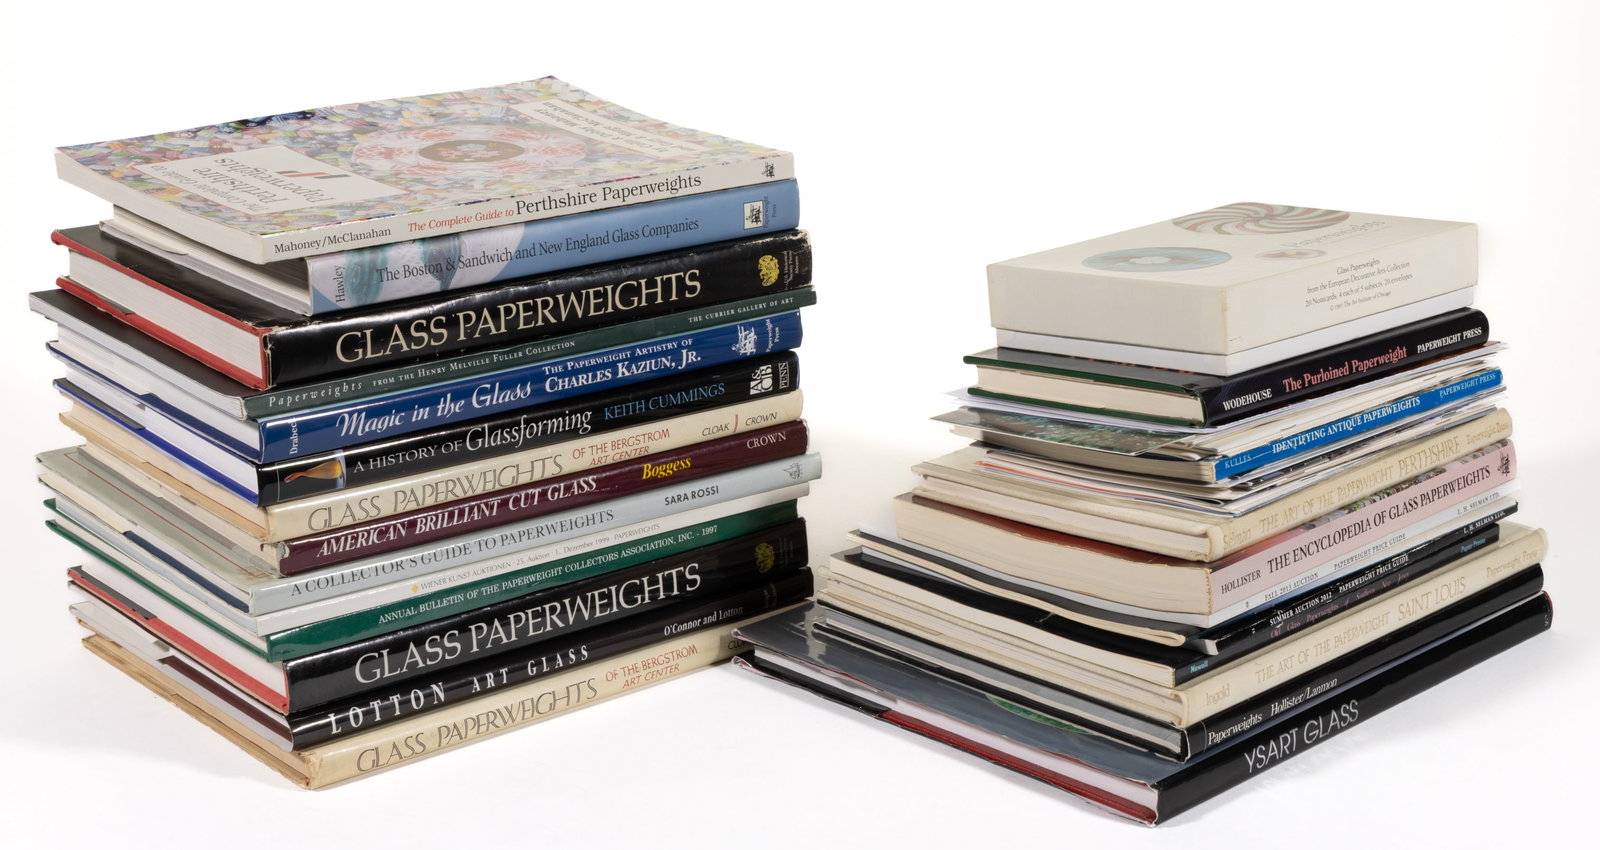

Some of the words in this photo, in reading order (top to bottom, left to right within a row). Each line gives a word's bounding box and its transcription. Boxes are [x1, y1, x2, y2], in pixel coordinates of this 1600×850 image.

[192, 167, 290, 204] Perthshire
[274, 227, 392, 254] Mahoney/McClanahan
[408, 222, 426, 233] The
[428, 214, 472, 230] Complete
[475, 208, 502, 222] Guide
[504, 208, 514, 217] to
[516, 191, 598, 215] Perthshire
[602, 174, 702, 202] Paperweights
[332, 264, 346, 302] Hawley
[376, 268, 400, 283] The
[403, 260, 442, 278] Boston
[446, 257, 457, 271] &
[458, 248, 512, 270] Sandwich
[515, 244, 536, 260] and
[538, 241, 563, 256] New
[565, 230, 610, 253] England
[612, 227, 640, 243] Glass
[641, 218, 699, 238] Companies
[1328, 279, 1350, 289] European
[1351, 271, 1376, 283] Decorative
[1387, 261, 1410, 272] Collection
[1350, 259, 1380, 272] Paperweights
[268, 380, 363, 407] Paperweights
[372, 377, 395, 387] FROM
[398, 372, 415, 381] THE
[418, 365, 446, 378] HENRY
[449, 356, 490, 372] MELVILLE
[493, 351, 523, 363] FULLER
[526, 340, 576, 356] COLLECTION
[705, 310, 735, 321] CURRIER
[737, 303, 767, 314] GALLERY
[780, 297, 794, 305] ART
[335, 316, 449, 364] GLASS
[456, 268, 702, 341] PAPERWEIGHTS
[336, 408, 405, 438] Magic
[412, 404, 430, 422] in
[437, 393, 465, 418] the
[472, 380, 532, 409] Glass
[542, 363, 564, 375] THE
[567, 351, 631, 370] PAPERWEIGHT
[634, 341, 679, 358] ARTISTRY
[682, 338, 693, 347] OF
[545, 367, 612, 393] CHARLES
[616, 355, 676, 378] KAZIUN,
[678, 349, 701, 370] JR.
[780, 362, 788, 389] PENN
[1223, 388, 1272, 411] WODEHOUSE
[1282, 376, 1302, 393] The
[1303, 361, 1350, 387] Purloined
[1352, 346, 1407, 374] Paperweight
[1417, 334, 1461, 354] PAPERWEIGHT
[1462, 326, 1482, 341] PRESS
[353, 463, 364, 474] A
[369, 448, 437, 470] HISTORY
[441, 440, 463, 454] OF
[465, 408, 592, 451] Glassforming
[604, 399, 646, 420] KEITH
[649, 383, 726, 410] CUMMINGS
[588, 456, 610, 467] ART
[611, 446, 650, 462] CENTER
[1224, 454, 1251, 469] KULLES
[1272, 428, 1326, 454] IDENTIFYING
[1327, 415, 1362, 439] ANTIQUE
[1363, 396, 1421, 424] PAPERWEIGHTS
[1439, 377, 1480, 398] PAPERWEIGHT
[1480, 372, 1496, 384] PRESS
[308, 495, 381, 532] GLASS
[393, 454, 563, 513] PAPERWEIGHTS
[572, 448, 586, 459] OF
[588, 443, 609, 456] THE
[611, 428, 670, 453] BERGSTROM
[702, 423, 730, 437] CLOAK
[745, 412, 778, 427] CROWN
[317, 523, 407, 558] AMERICAN
[415, 500, 501, 535] BRILLIANT
[509, 489, 542, 510] CUT
[547, 476, 597, 501] GLASS
[642, 457, 692, 480] Boggess
[746, 432, 787, 449] CROWN
[1260, 514, 1279, 533] THE
[1281, 506, 1300, 525] ART
[1318, 491, 1335, 511] THE
[1337, 465, 1394, 502] PAPERWEIGHT
[1398, 435, 1460, 477] PERTHSHIRE
[291, 585, 302, 596] A
[305, 558, 418, 591] COLLECTOR'S
[420, 543, 471, 564] GUIDE
[477, 537, 497, 551] TO
[500, 510, 614, 547] PAPERWEIGHTS
[664, 494, 690, 506] SARA
[691, 486, 719, 499] ROSSI
[472, 562, 512, 577] AUKTIONEN
[614, 523, 660, 539] PAPERWEIGHTS
[1221, 569, 1261, 595] HOLLISTER
[1267, 551, 1291, 574] THE
[1293, 517, 1371, 563] ENCYCLOPEDIA
[1373, 510, 1387, 527] OF
[1388, 497, 1418, 520] GLASS
[1420, 465, 1491, 508] PAPERWEIGHTS
[1293, 572, 1319, 588] AUCTION
[1333, 549, 1371, 570] PAPERWEIGHT
[1372, 540, 1388, 554] PRICE
[1389, 533, 1406, 546] GUIDE
[379, 608, 417, 624] ANNUAL
[419, 594, 464, 612] BULLETIN
[467, 591, 478, 599] OF
[480, 584, 500, 595] THE
[501, 566, 562, 590] PAPERWEIGHT
[564, 552, 619, 574] COLLECTORS
[620, 538, 676, 557] ASSOCIATION,
[678, 532, 695, 542] INC.
[702, 525, 718, 536] 1997
[1294, 600, 1320, 615] AUCTION
[1339, 571, 1376, 593] PAPERWEIGHT
[1376, 564, 1392, 577] PRICE
[1392, 555, 1409, 568] GUIDE
[354, 630, 462, 684] GLASS
[468, 563, 701, 653] PAPERWEIGHTS
[1206, 683, 1230, 706] Ingold
[1255, 669, 1274, 684] THE
[1278, 656, 1294, 673] ART
[1297, 649, 1310, 664] OF
[1313, 638, 1330, 656] THE
[1334, 611, 1390, 646] PAPERWEIGHT
[1398, 590, 1432, 621] SAINT
[1435, 576, 1466, 603] LOUIS
[328, 682, 445, 734] LOTTON
[472, 668, 509, 693] ART
[527, 645, 588, 676] GLASS
[664, 619, 701, 636] O'Connor
[703, 613, 717, 624] and
[719, 606, 743, 620] Lotton
[622, 677, 641, 689] ART
[642, 664, 680, 684] CENTER
[1190, 660, 1208, 673] Newell
[357, 732, 426, 772] GLASS
[437, 677, 598, 748] PAPERWEIGHTS
[605, 671, 618, 682] OF
[620, 663, 640, 678] THE
[641, 644, 698, 674] BERGSTROM
[1208, 712, 1263, 745] Paperweights
[1270, 677, 1338, 716] Hollister/Lanmon
[1244, 727, 1299, 774] YSART
[1304, 700, 1359, 744] GLASS
